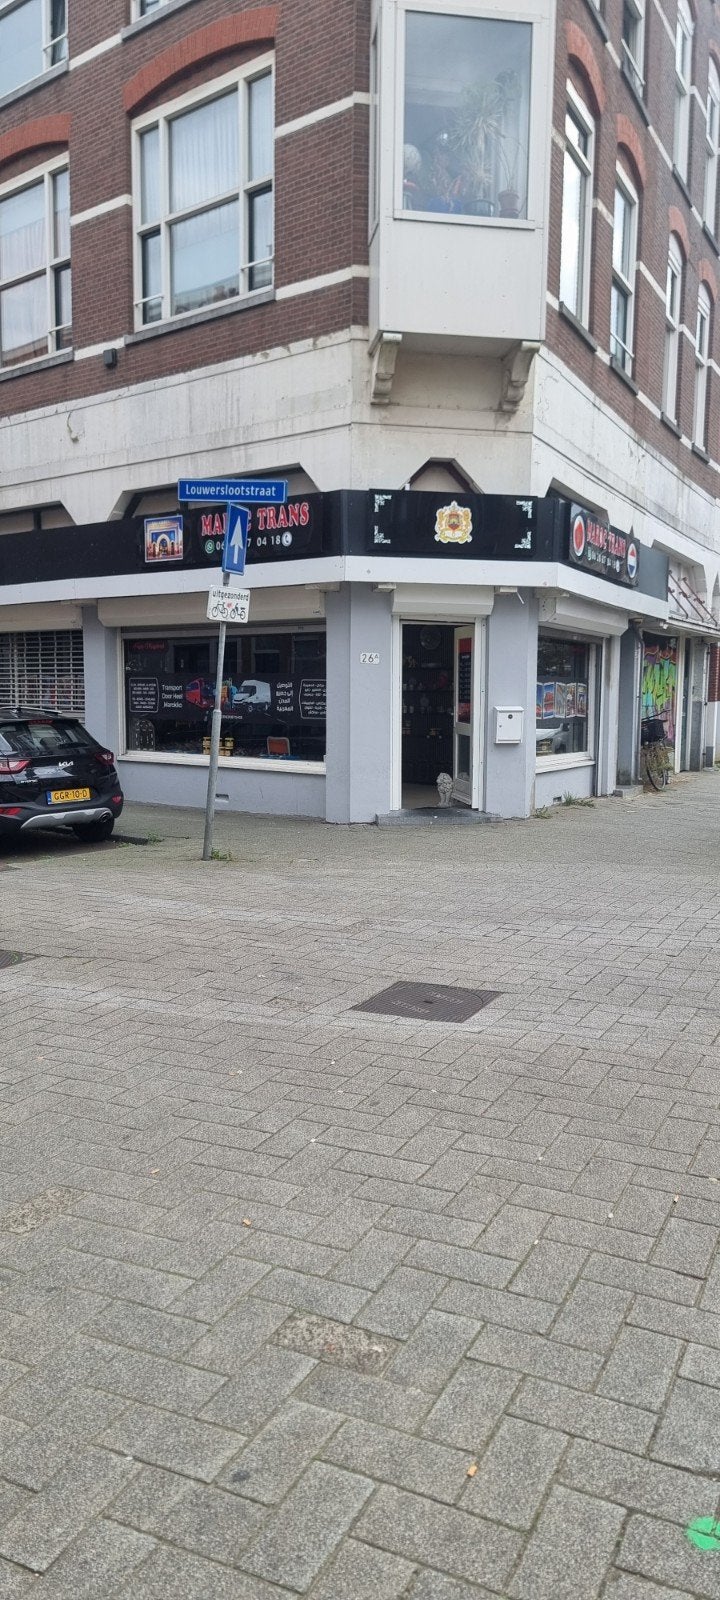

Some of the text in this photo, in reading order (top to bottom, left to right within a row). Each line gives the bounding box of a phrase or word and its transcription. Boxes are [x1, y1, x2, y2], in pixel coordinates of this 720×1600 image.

[185, 484, 277, 497] Louwerslootstraat
[257, 502, 309, 531] TRANS
[256, 536, 267, 547] 04
[271, 535, 281, 545] 18
[212, 589, 249, 602] uitgezonderd
[58, 760, 74, 768] KIA
[54, 789, 87, 801] GGR-10-D
